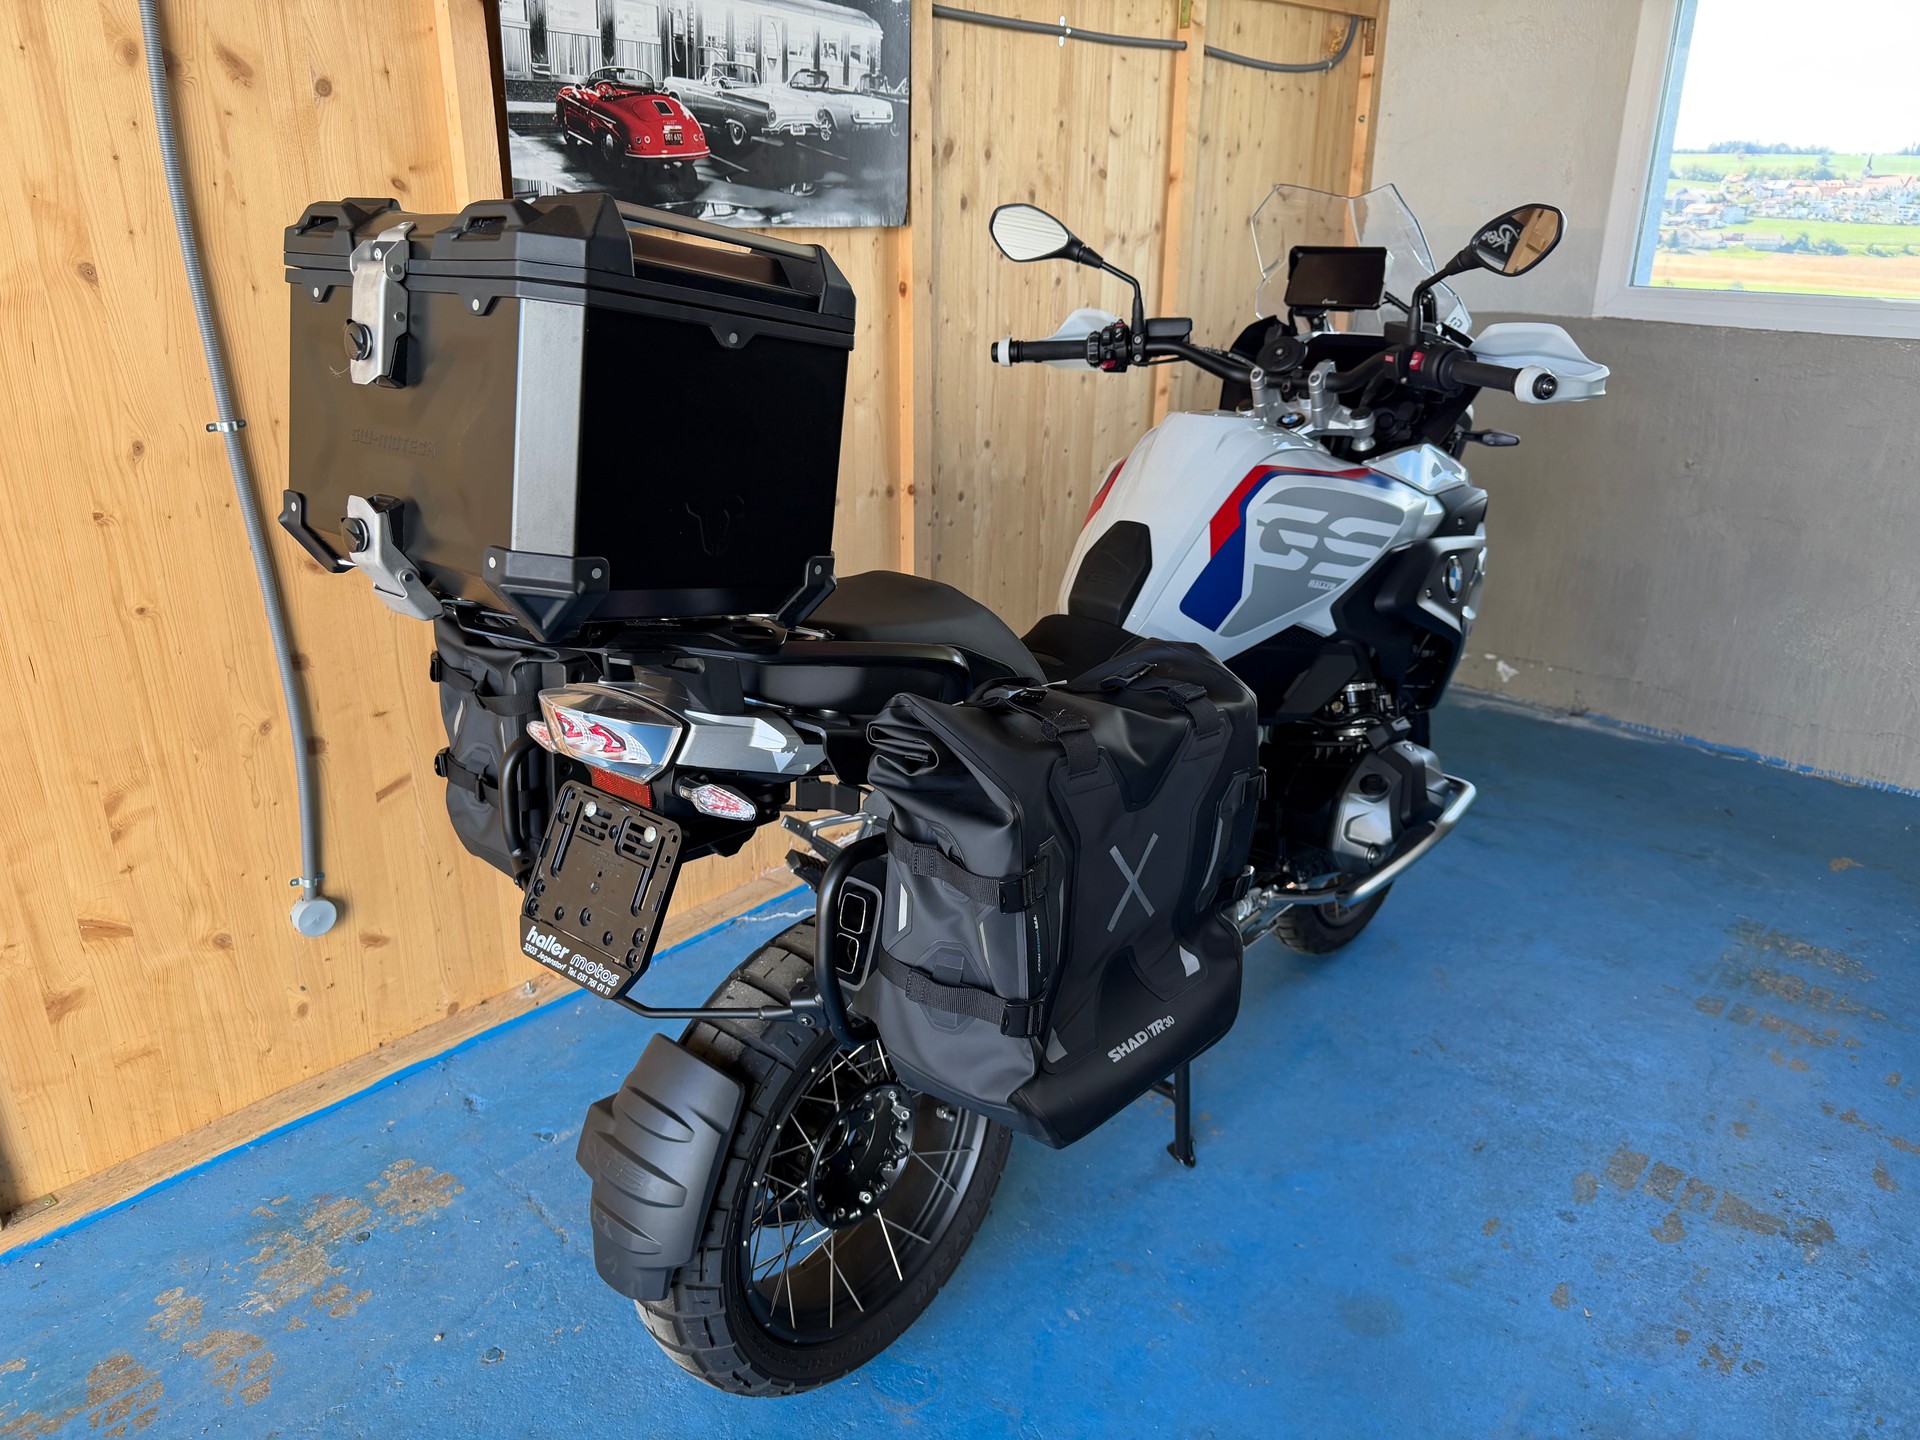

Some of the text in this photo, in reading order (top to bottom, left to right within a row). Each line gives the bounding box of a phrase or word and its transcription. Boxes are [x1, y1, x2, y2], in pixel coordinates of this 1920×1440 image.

[523, 942, 538, 955] 3303
[567, 966, 577, 978] Tel.
[576, 972, 588, 984] 031
[596, 983, 605, 992] 01
[604, 987, 611, 996] 11
[526, 925, 620, 987] haller motos
[1107, 1030, 1149, 1063] SHAD
